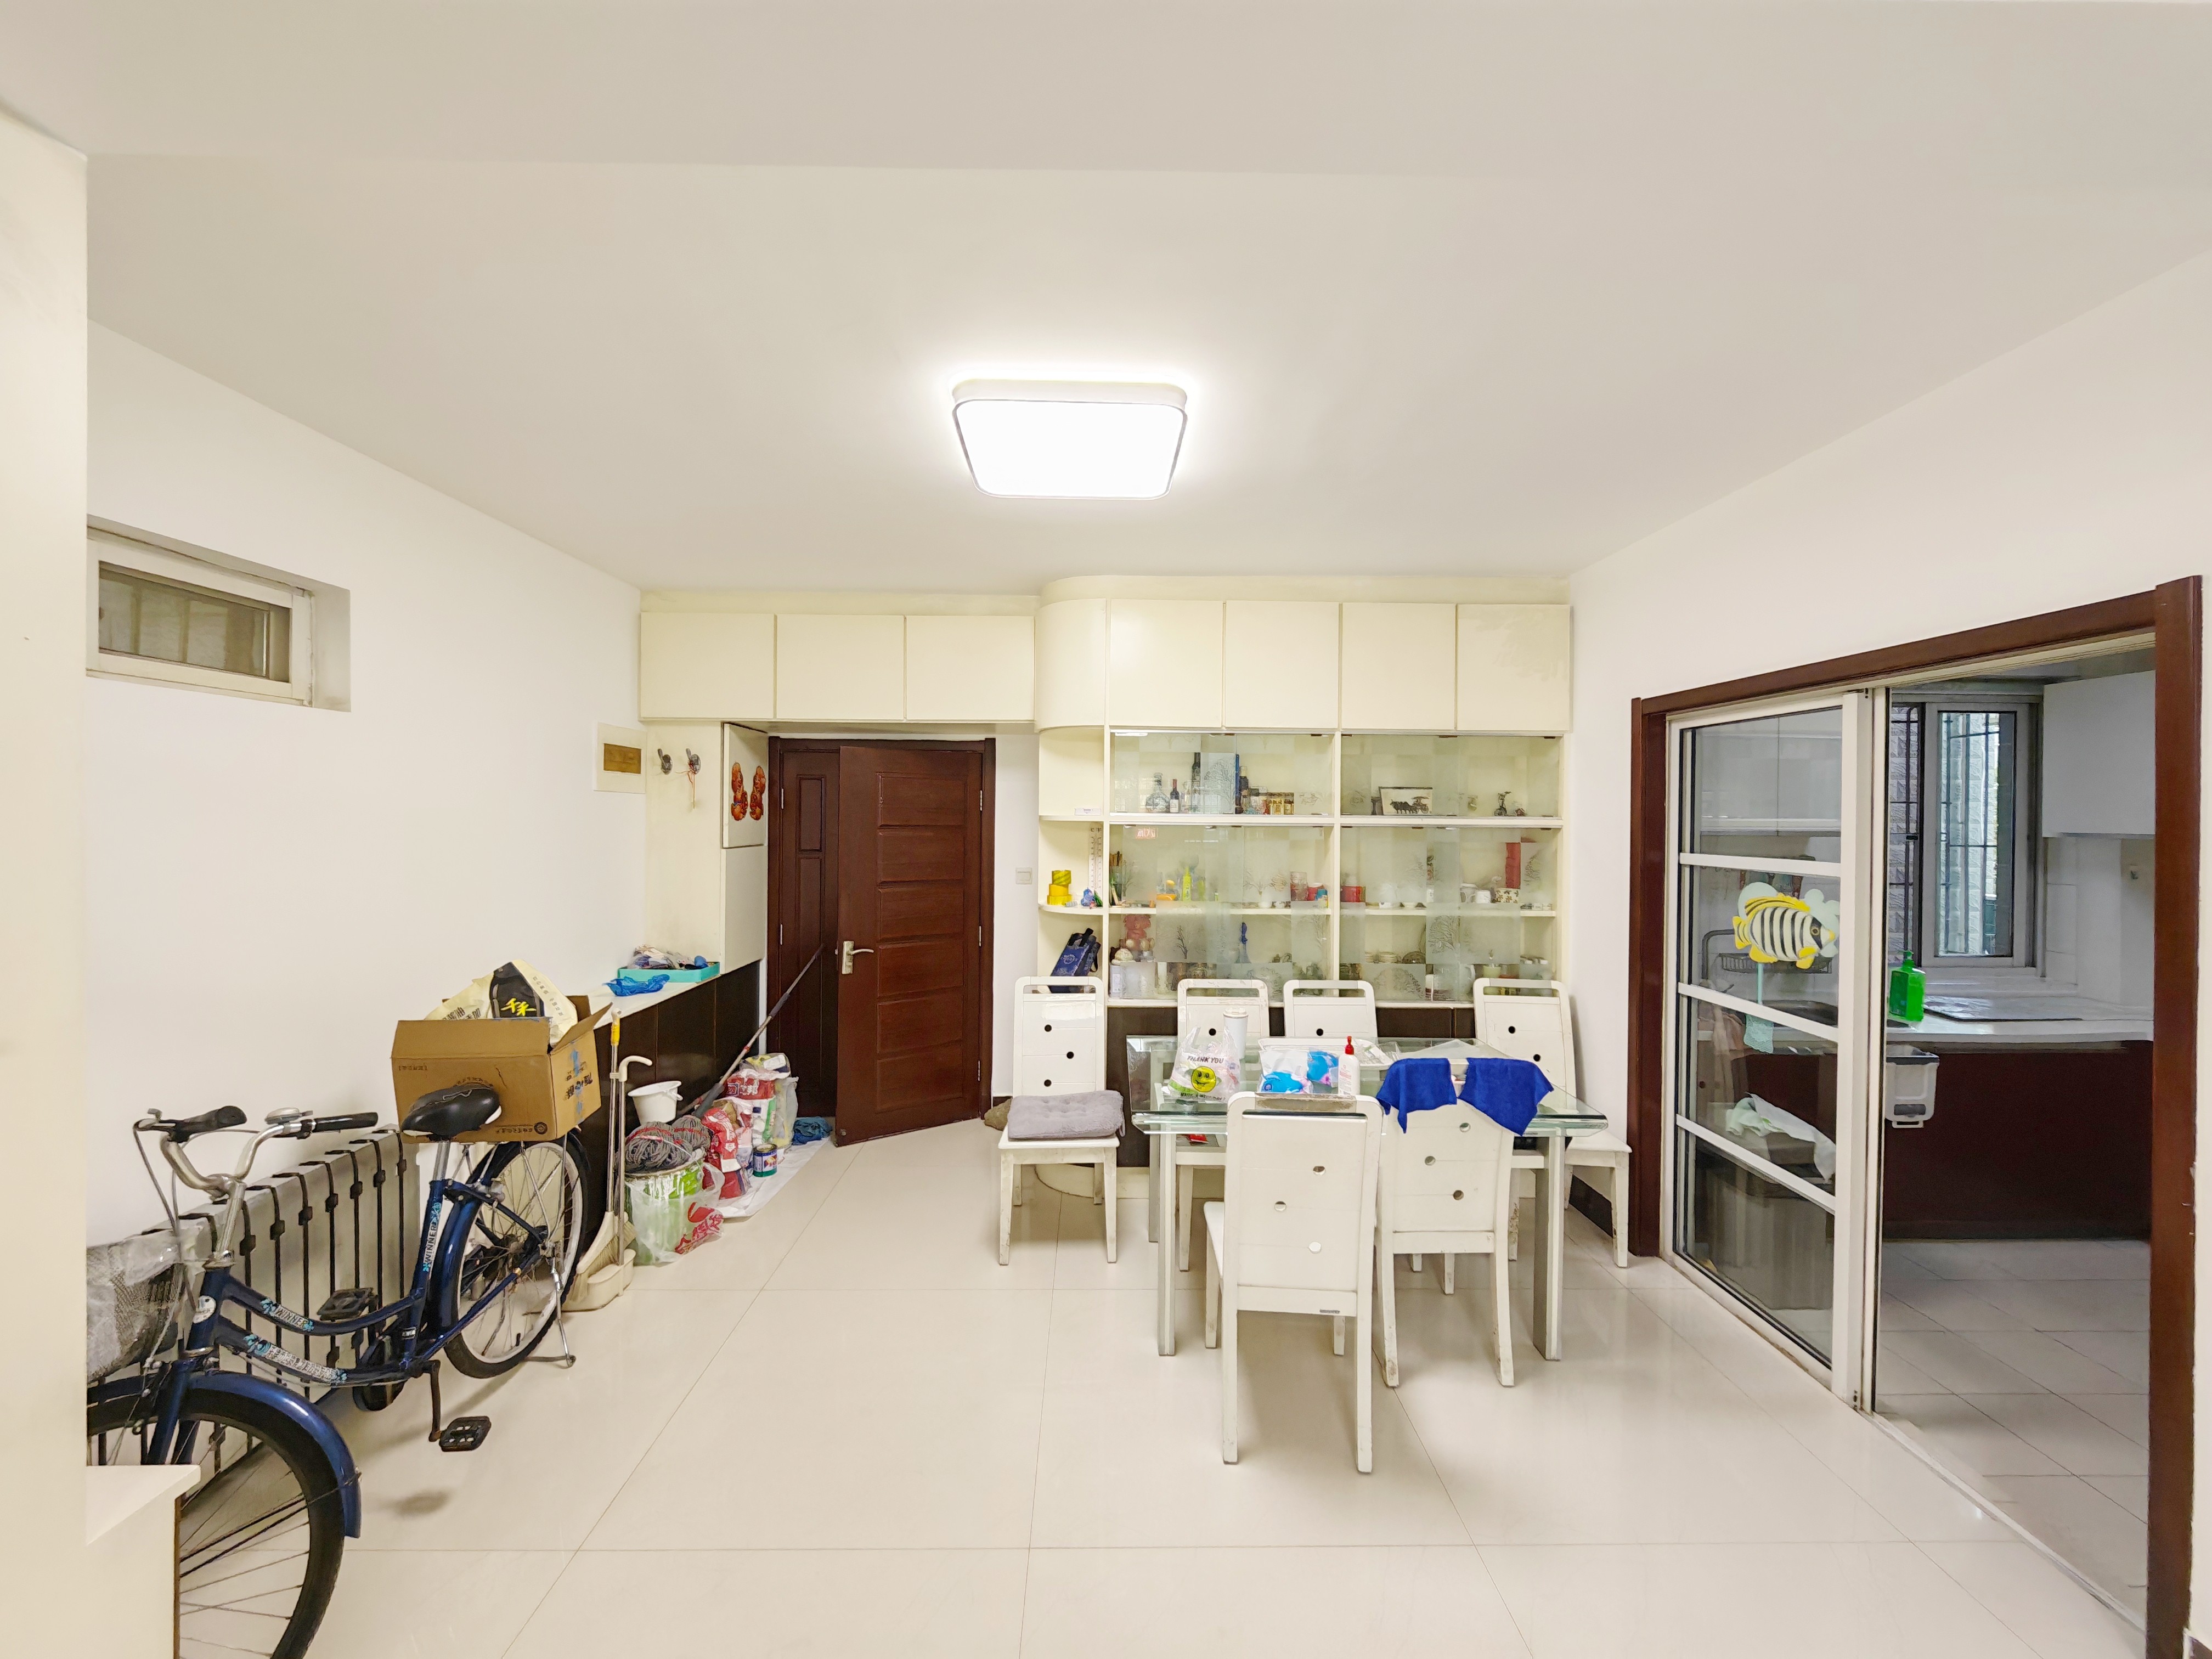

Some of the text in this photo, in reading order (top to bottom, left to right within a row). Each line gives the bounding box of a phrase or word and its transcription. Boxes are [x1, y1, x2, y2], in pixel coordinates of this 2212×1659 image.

[1187, 1055, 1210, 1063] THANK
[424, 1223, 438, 1262] WINNER
[275, 1304, 309, 1329] WINNER
